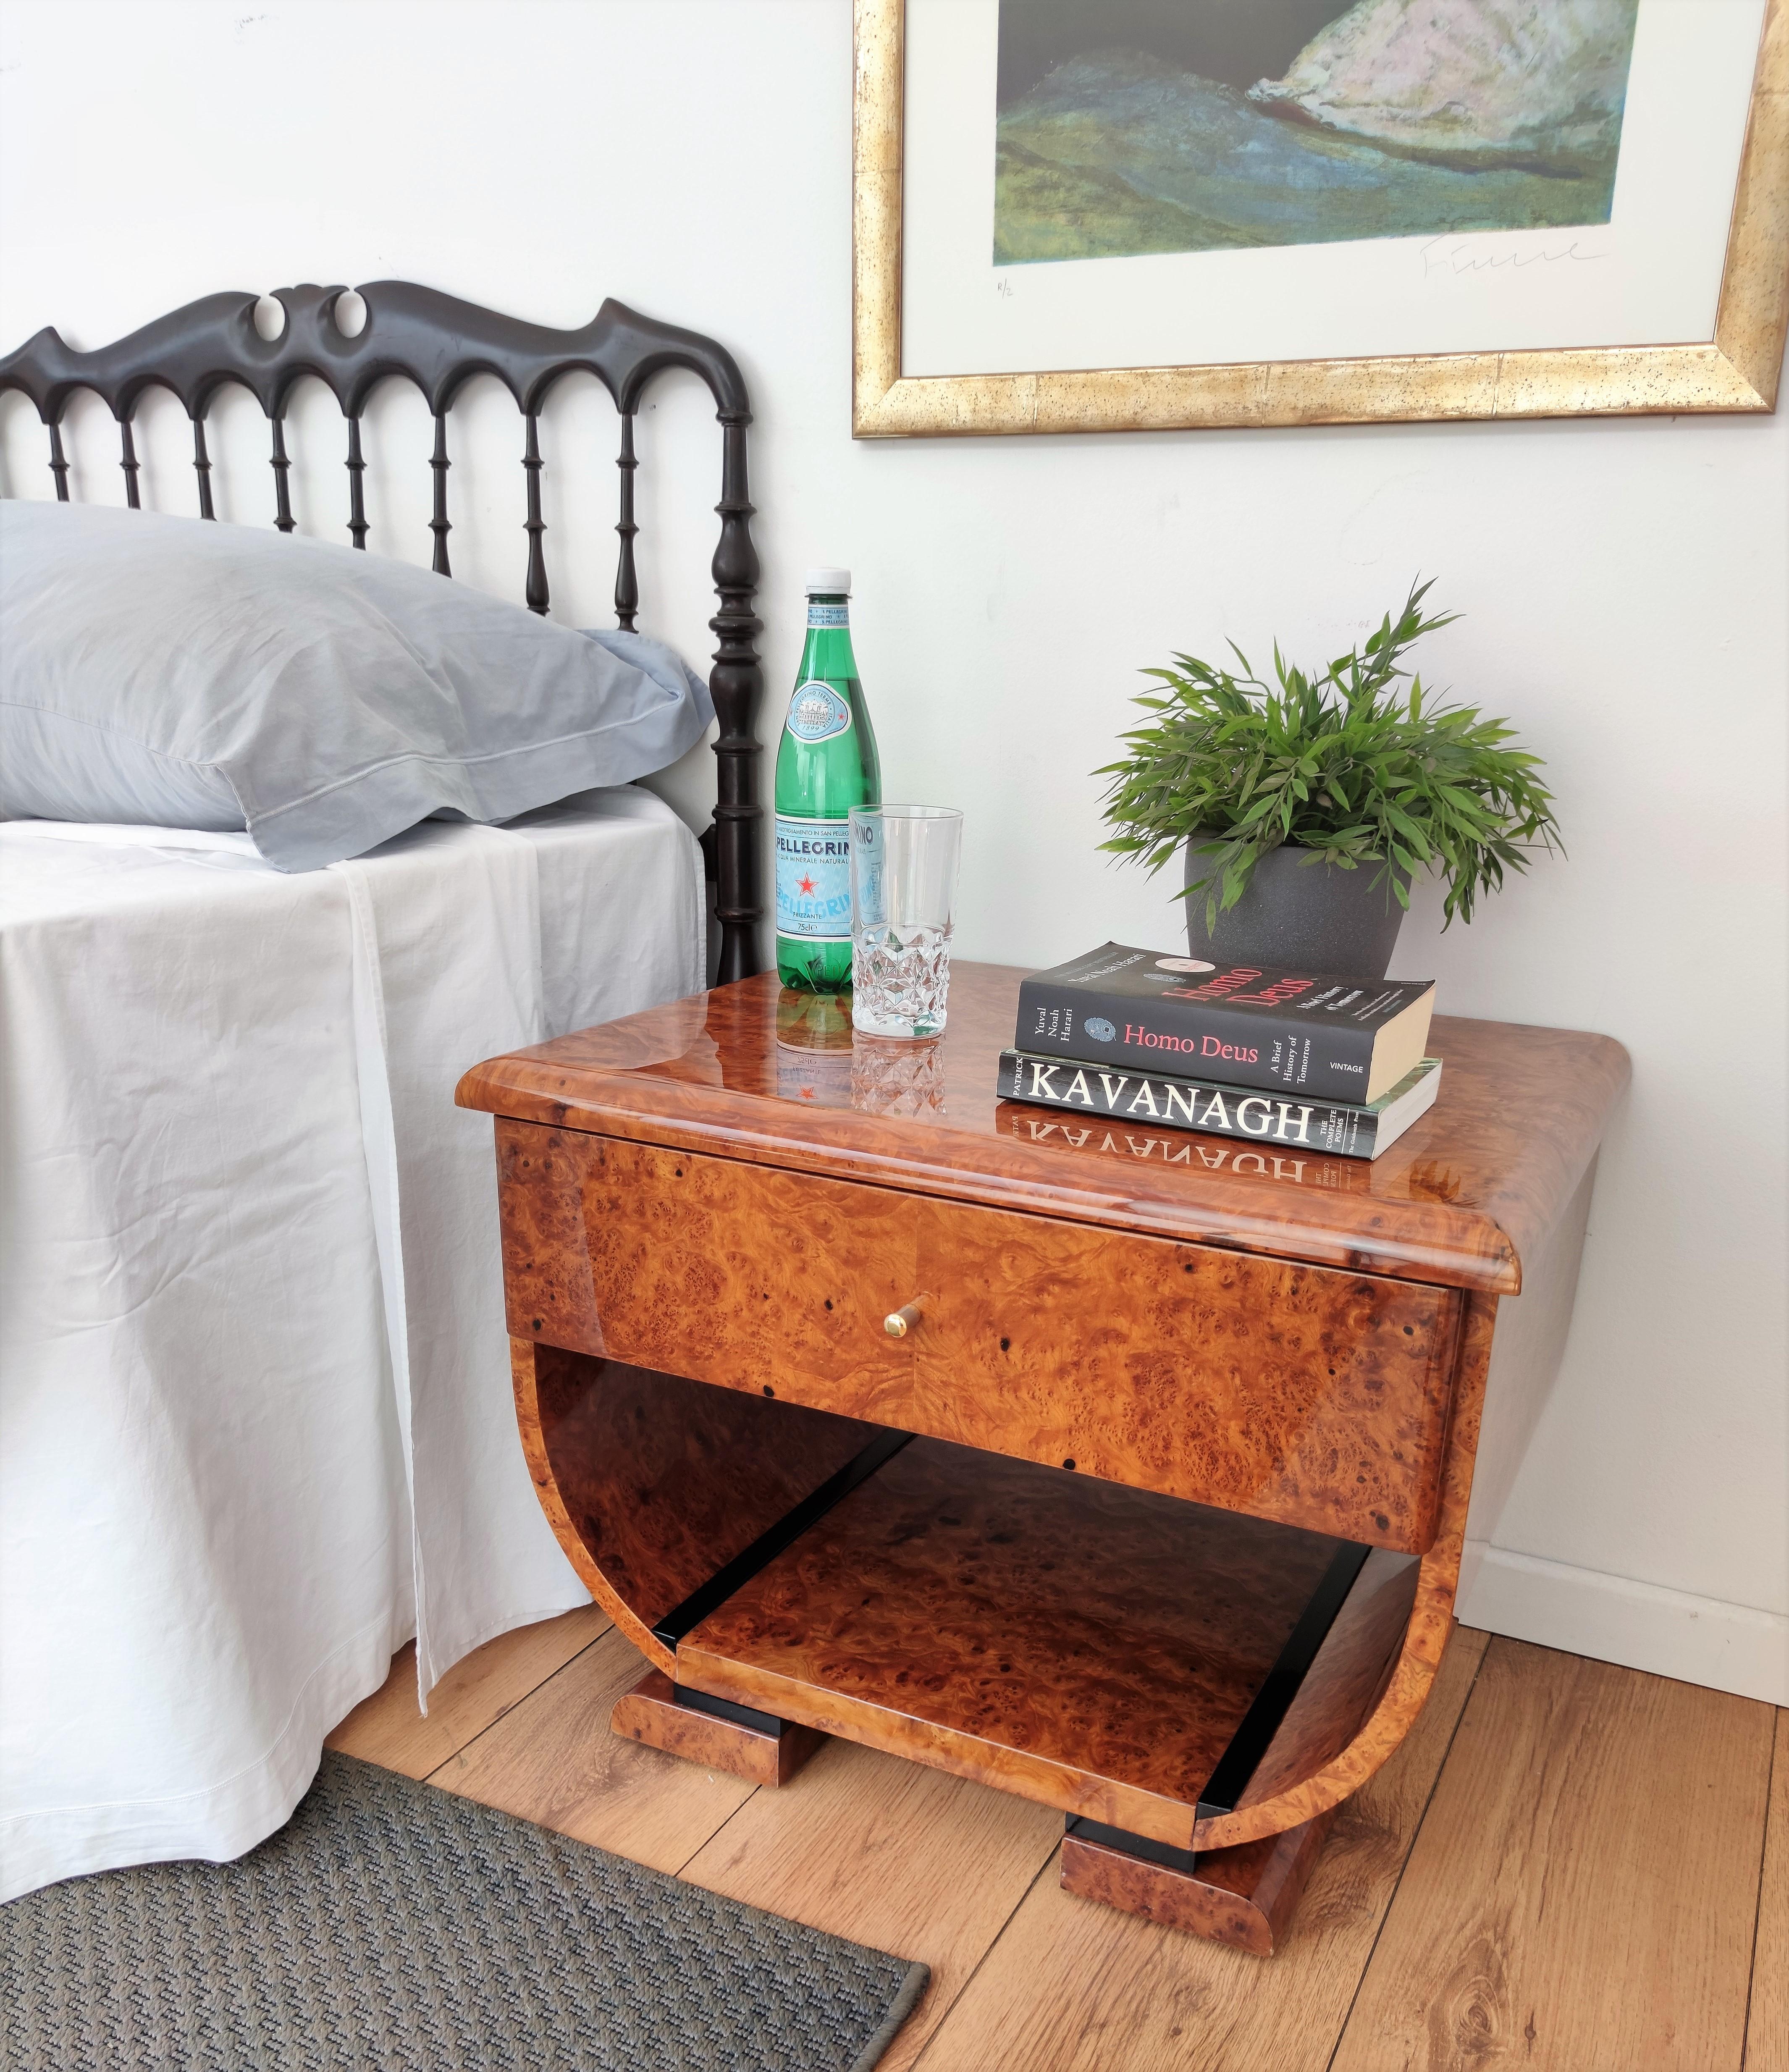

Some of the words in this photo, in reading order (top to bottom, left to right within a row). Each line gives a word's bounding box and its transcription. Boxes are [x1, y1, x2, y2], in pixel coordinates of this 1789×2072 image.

[818, 691, 832, 706] TERME
[822, 713, 833, 728] ITALIA
[1067, 973, 1099, 983] Yuval
[1089, 965, 1123, 975] Noah
[1111, 953, 1147, 967] Harari
[1162, 968, 1262, 1002] Homo
[1225, 978, 1314, 1007] Deus
[1300, 998, 1325, 1007] Brief
[1314, 986, 1349, 999] History
[1327, 990, 1364, 1007] Tomorrow
[1035, 1007, 1047, 1035] Yuval
[1048, 1009, 1059, 1037] Noah
[1060, 1008, 1073, 1042] Harari
[1123, 1024, 1194, 1053] Homo
[1200, 1035, 1258, 1063] Deus
[1271, 1039, 1283, 1063] Brief
[1288, 1034, 1297, 1046] of
[1283, 1048, 1298, 1082] History
[1296, 1038, 1311, 1084] Tomorrow
[1330, 1062, 1364, 1073] VINTAGE
[1013, 1057, 1023, 1096] PATRICK
[1028, 1062, 1314, 1142] KAVANAGH
[1326, 1109, 1337, 1149] COMPLETE
[1335, 1117, 1344, 1143] POEMS
